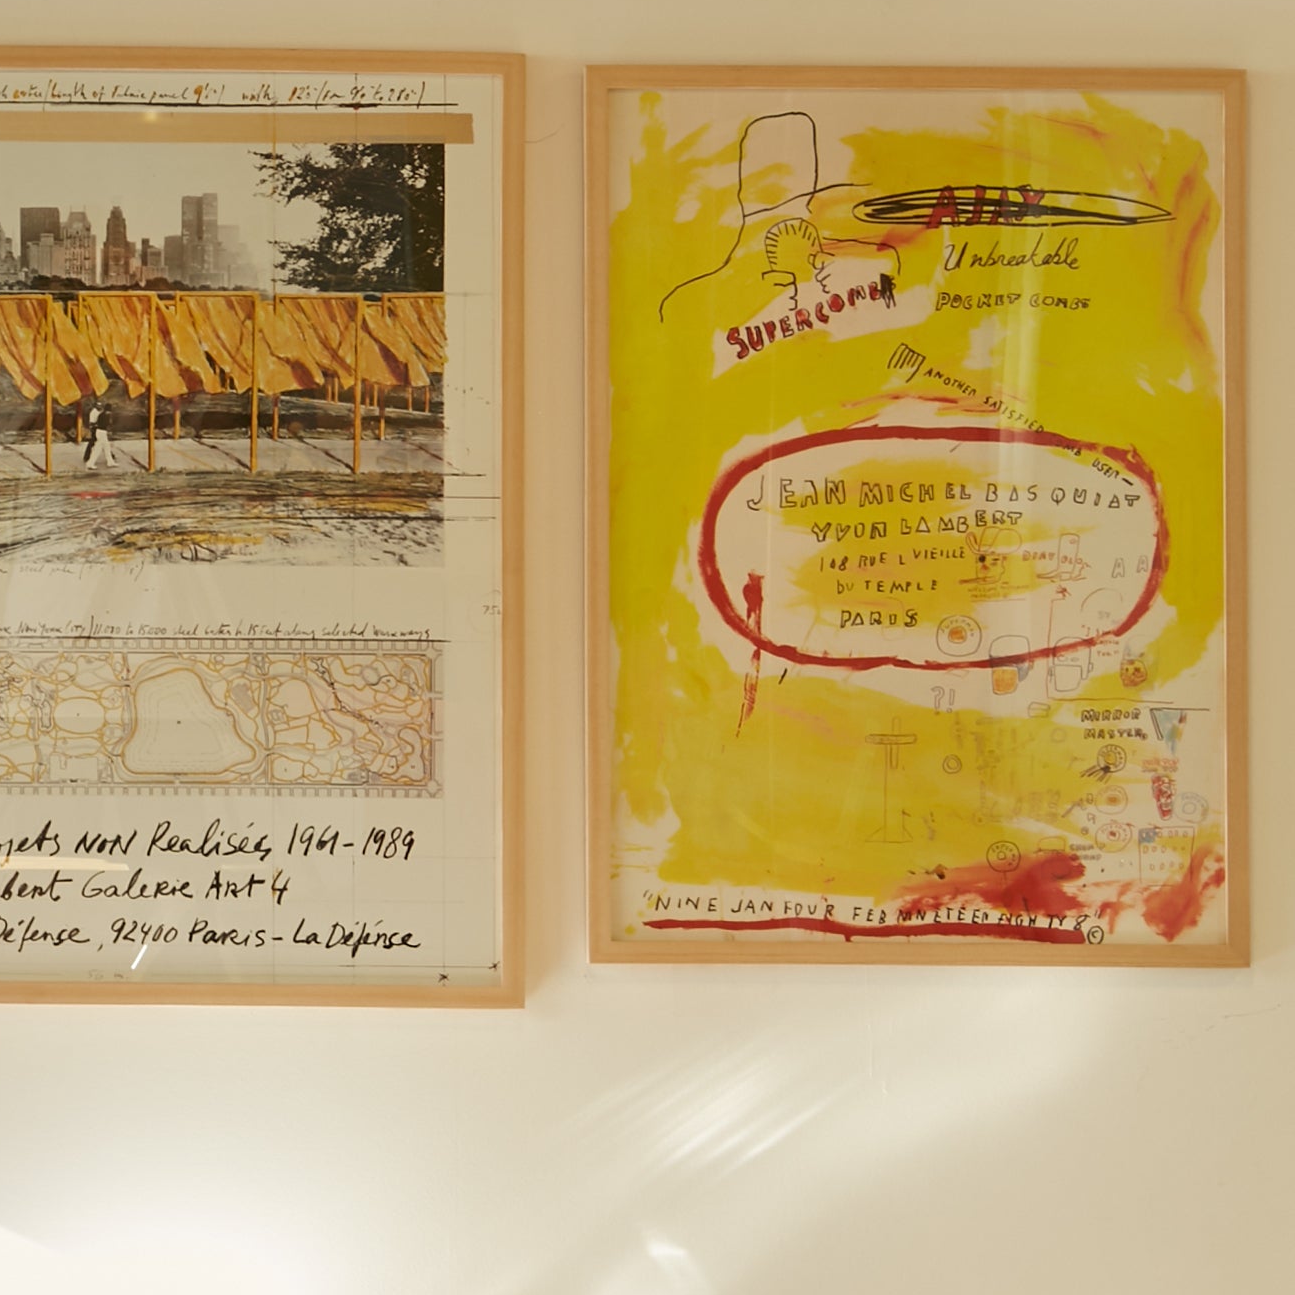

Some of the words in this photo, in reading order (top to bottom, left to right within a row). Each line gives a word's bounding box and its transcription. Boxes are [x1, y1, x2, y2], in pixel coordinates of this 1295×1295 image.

[935, 291, 1022, 313] POCKET
[1028, 293, 1092, 311] COMBS
[923, 366, 978, 398] ANOTHER
[982, 395, 1046, 435] SATISFIED
[811, 520, 888, 543] YVON
[900, 509, 1024, 536] LAMBERT
[863, 578, 939, 595] TEMPLE
[74, 829, 138, 856] NON
[81, 869, 194, 901] Galerie
[205, 868, 267, 901] Art
[730, 898, 774, 915] JAN
[783, 900, 836, 918] FOUR
[852, 905, 888, 925] FEB
[187, 917, 267, 948] Paris
[292, 917, 323, 946] La
